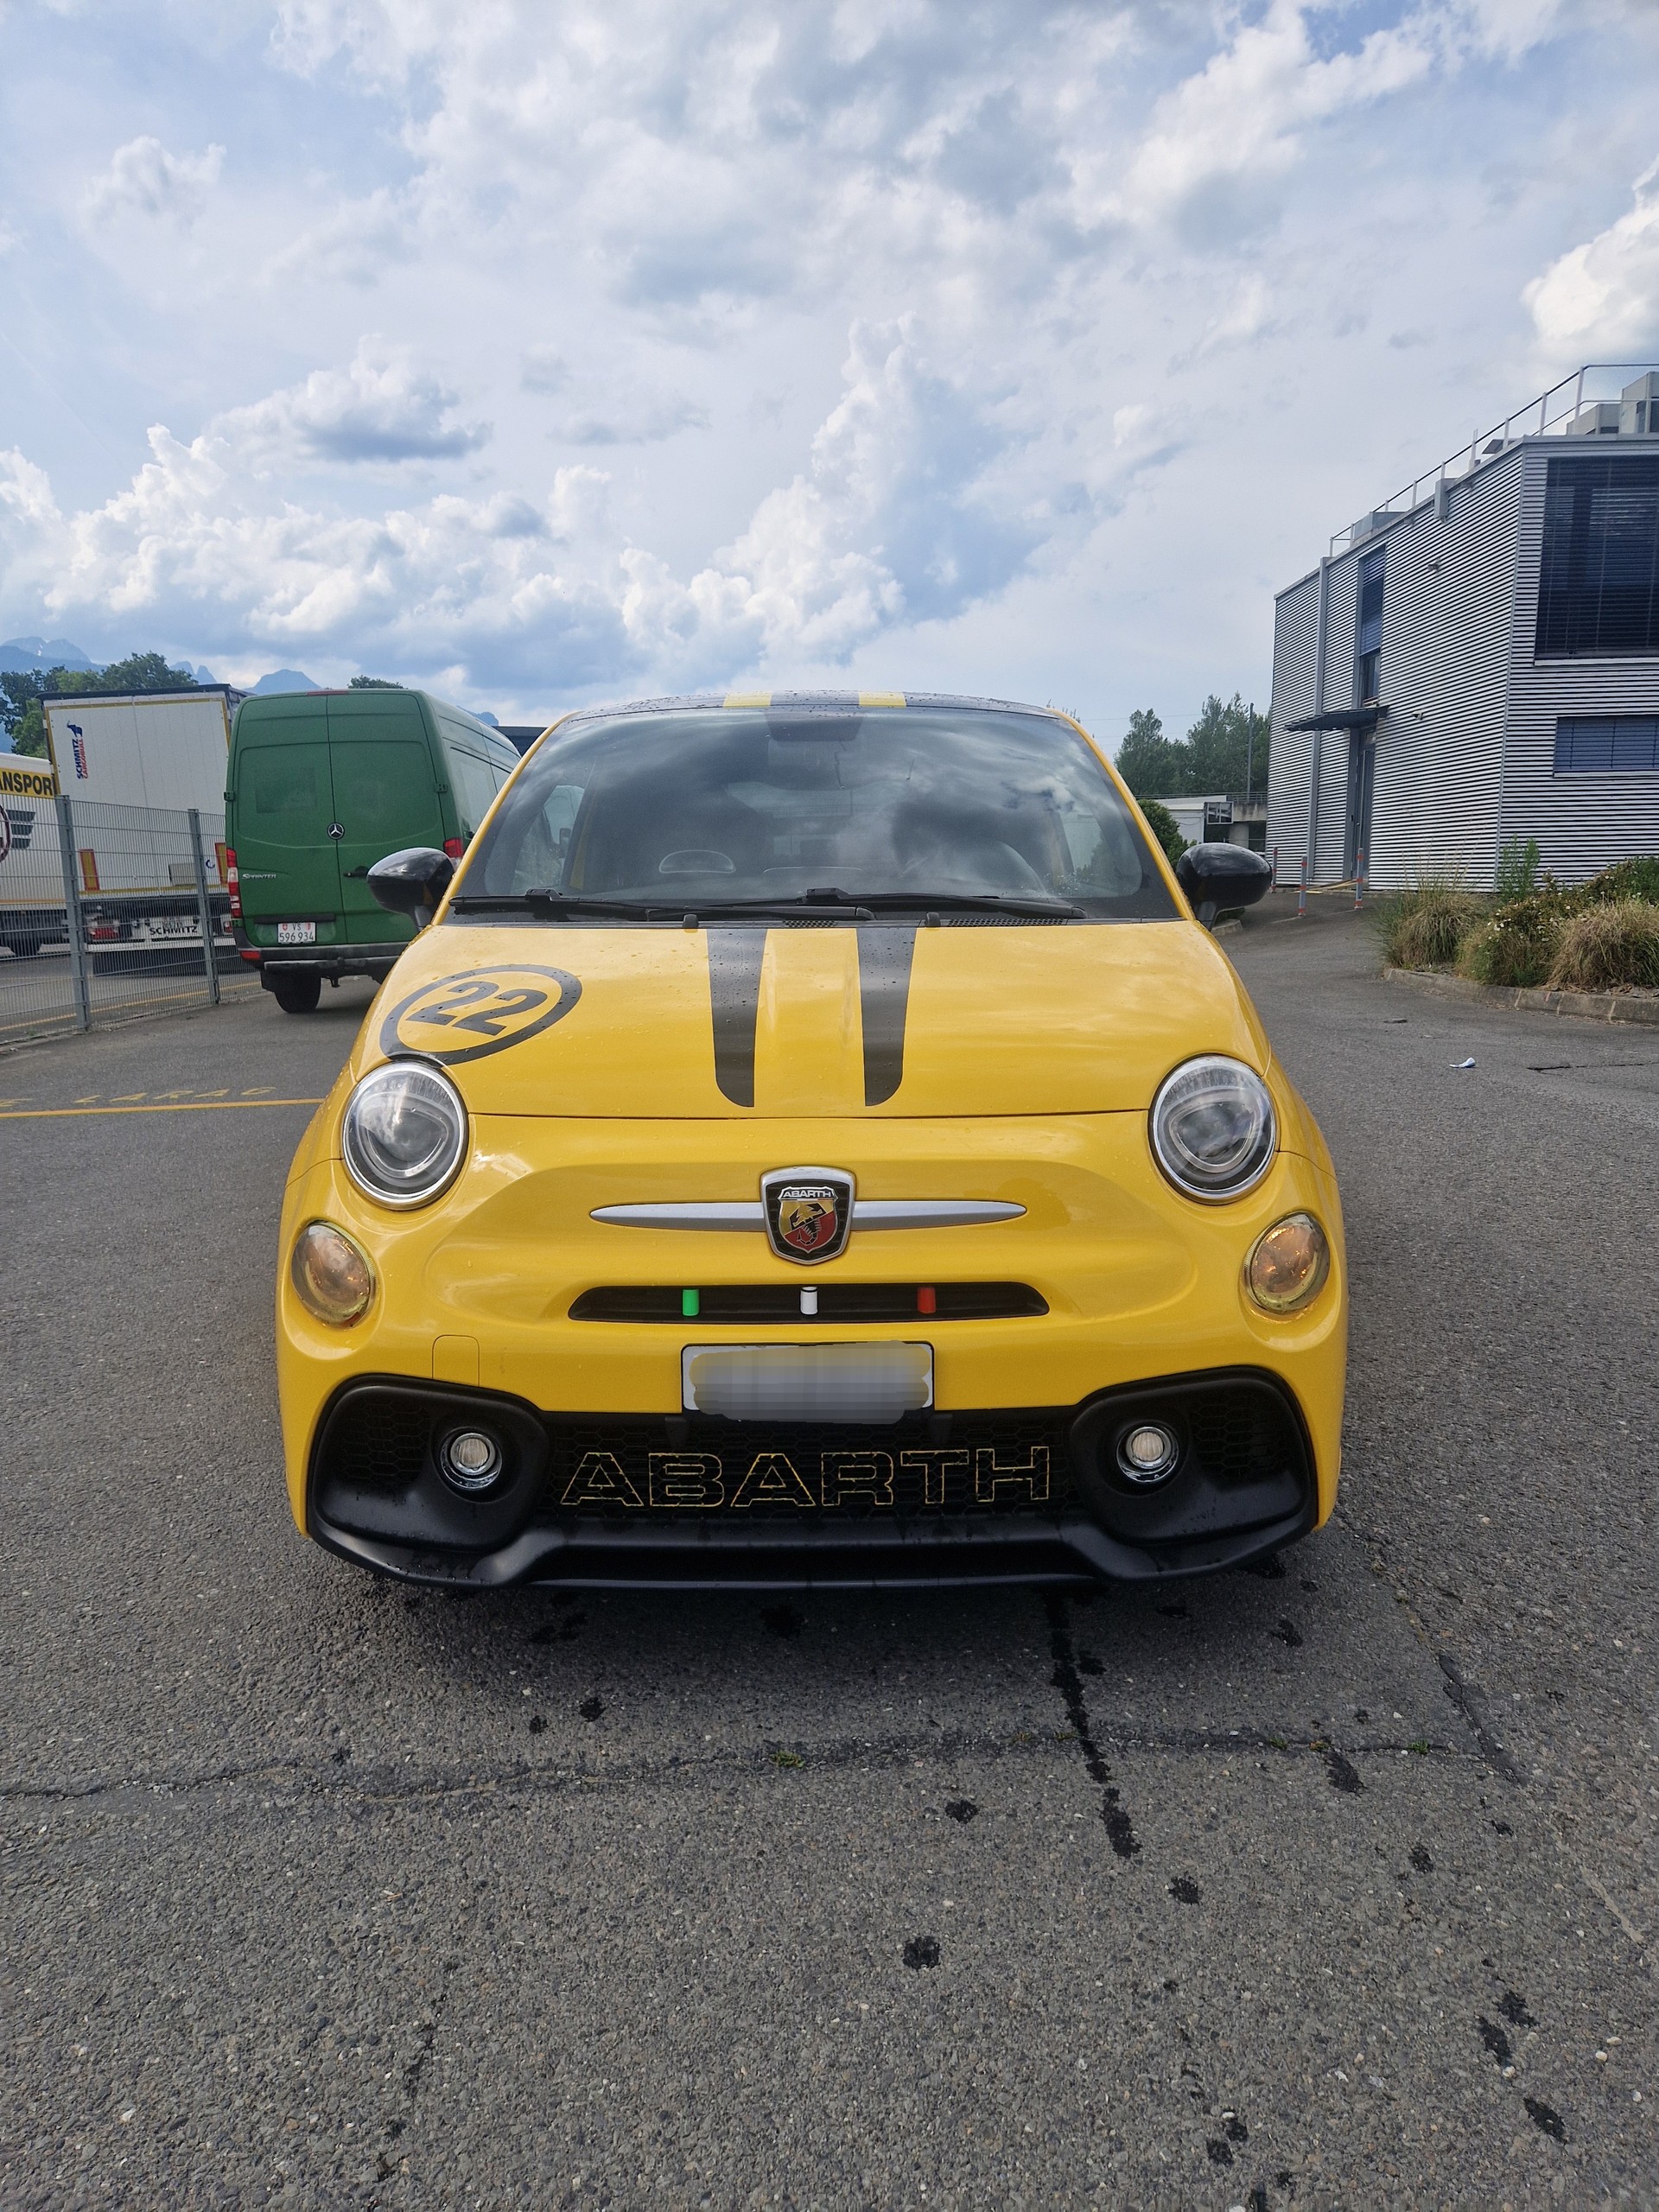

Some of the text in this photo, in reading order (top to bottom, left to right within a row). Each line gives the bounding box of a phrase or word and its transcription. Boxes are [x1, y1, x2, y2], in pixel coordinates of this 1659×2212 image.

[72, 739, 84, 779] SCHMITZ
[149, 925, 198, 935] SCHMITZ
[405, 981, 548, 1036] 22
[560, 1446, 1050, 1508] ABARTH
